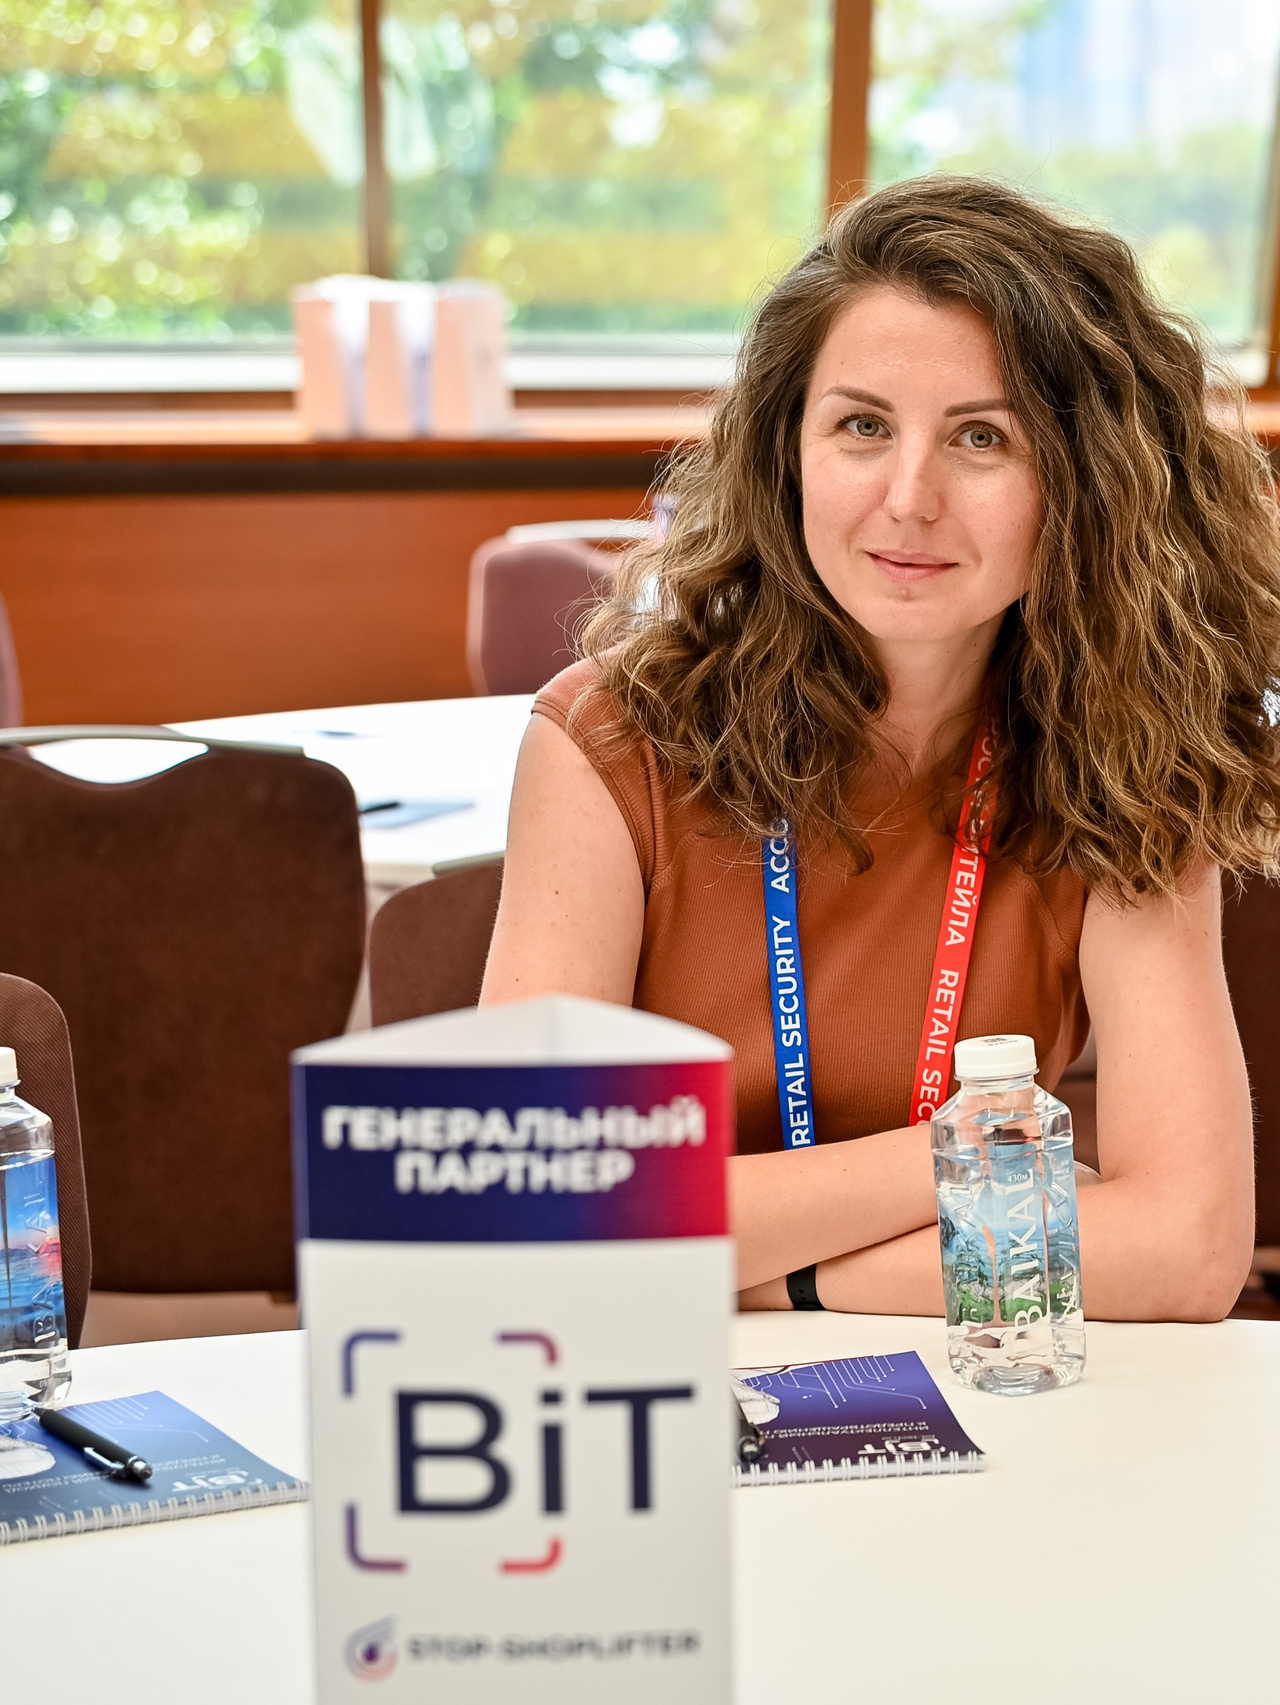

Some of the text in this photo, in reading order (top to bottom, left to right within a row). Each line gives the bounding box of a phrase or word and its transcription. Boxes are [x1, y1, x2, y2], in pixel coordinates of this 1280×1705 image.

[944, 818, 985, 947] ТЕЙЛА
[772, 915, 811, 1146] RETAIL SECURITY
[917, 968, 960, 1125] RETAIL SEC
[322, 1096, 705, 1151] ГЕНЕРАЛЬНЫЙ
[395, 1152, 635, 1194] ПАРТНЕР
[1005, 1168, 1043, 1334] BAIKAL
[408, 1629, 701, 1664] STOP-SHOPLIFTER
